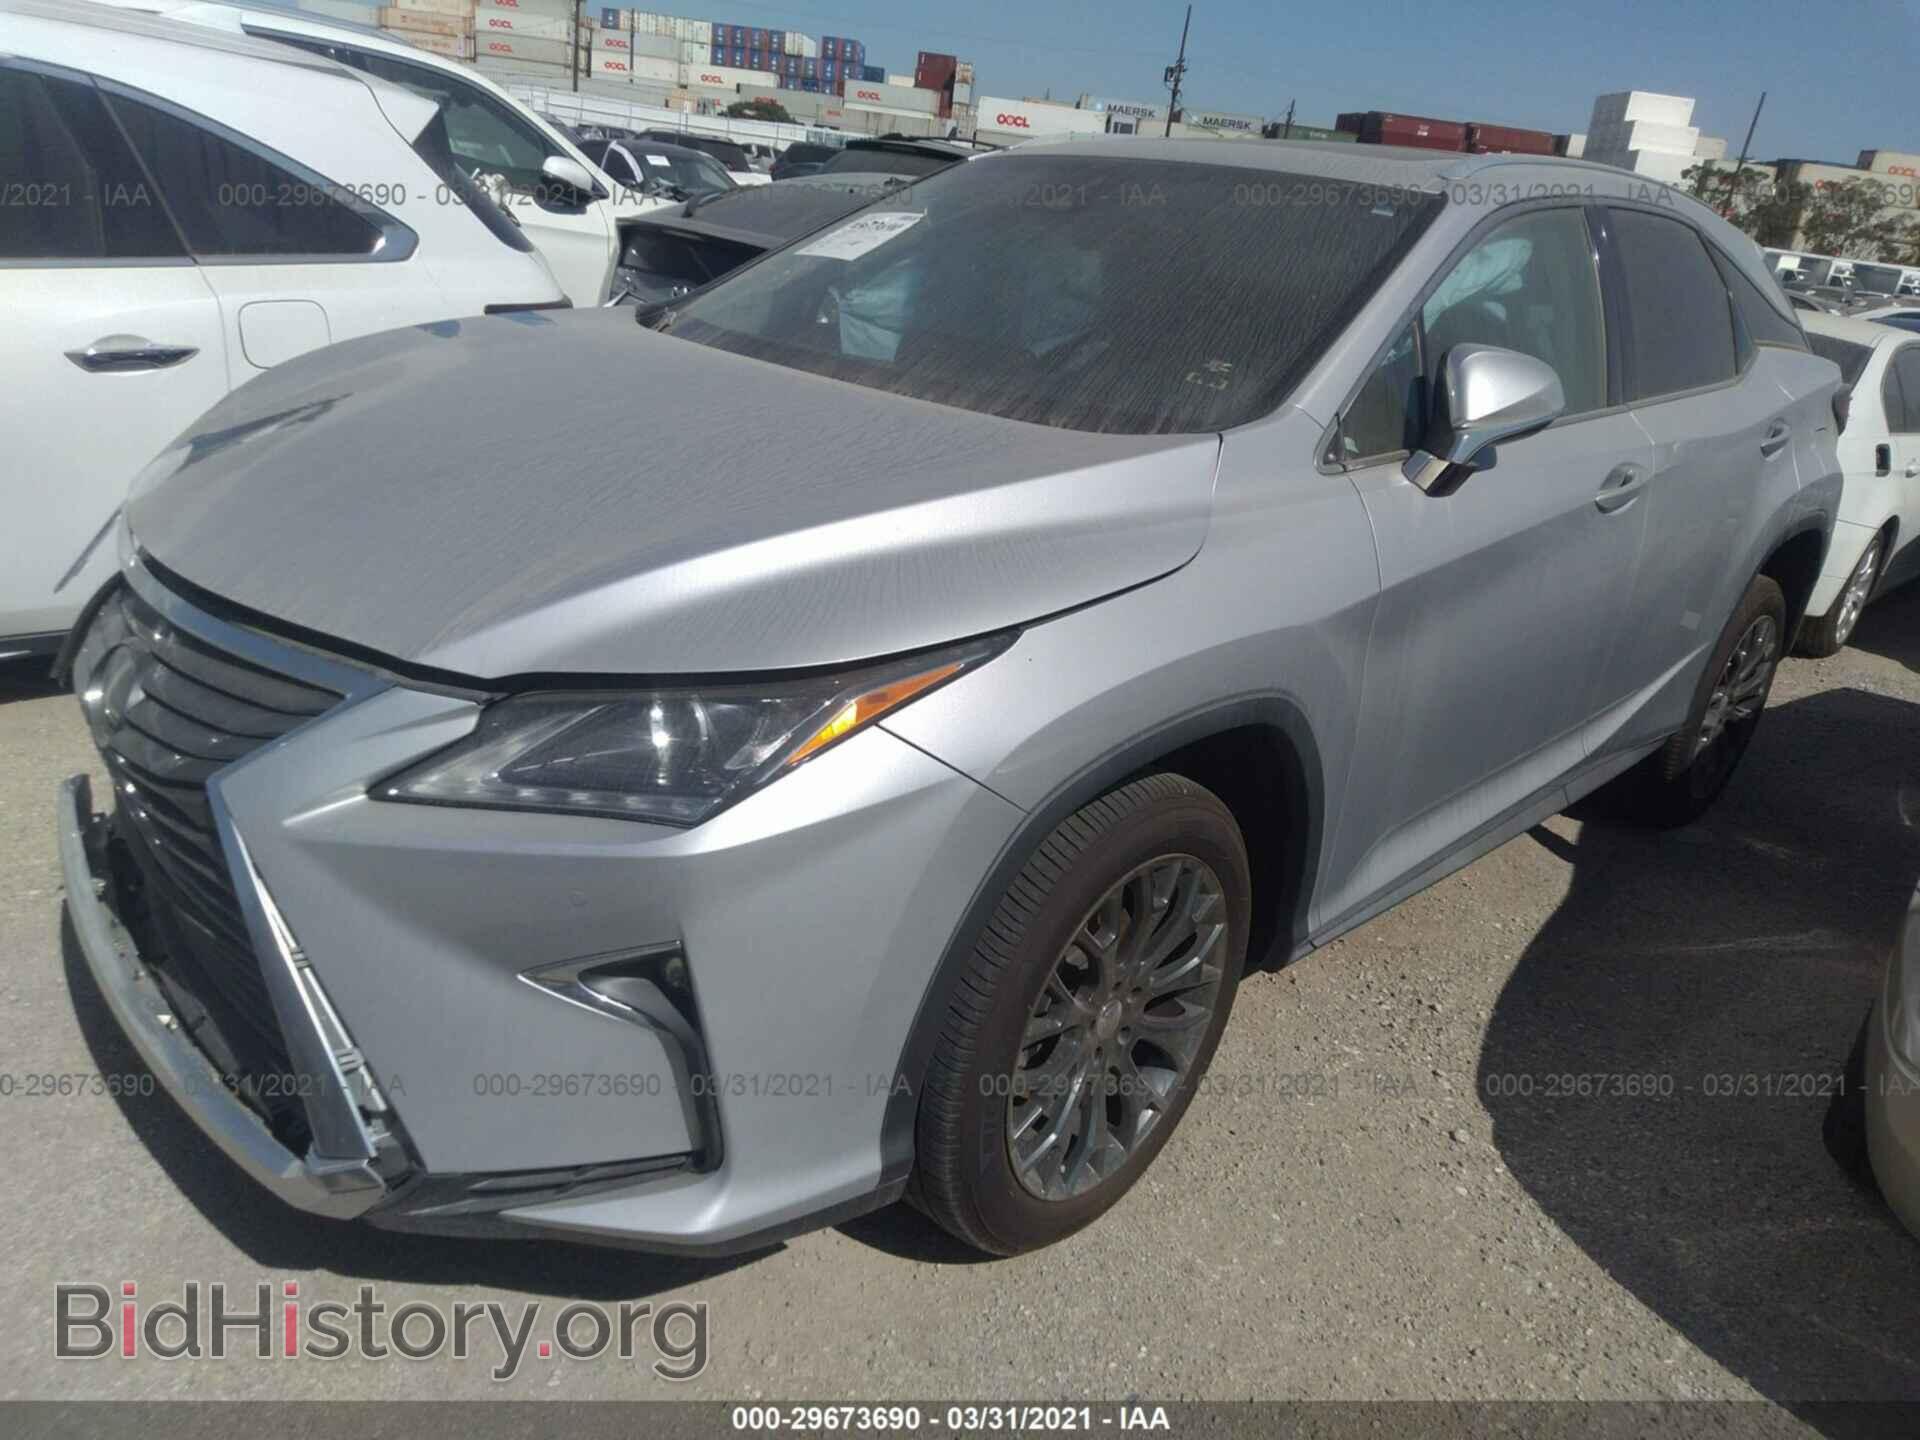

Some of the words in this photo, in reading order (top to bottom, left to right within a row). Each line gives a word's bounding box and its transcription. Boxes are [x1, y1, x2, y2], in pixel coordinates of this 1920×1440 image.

[1107, 103, 1156, 119] MAERSK
[996, 113, 1030, 128] OOCL
[1202, 115, 1253, 131] MAERSK
